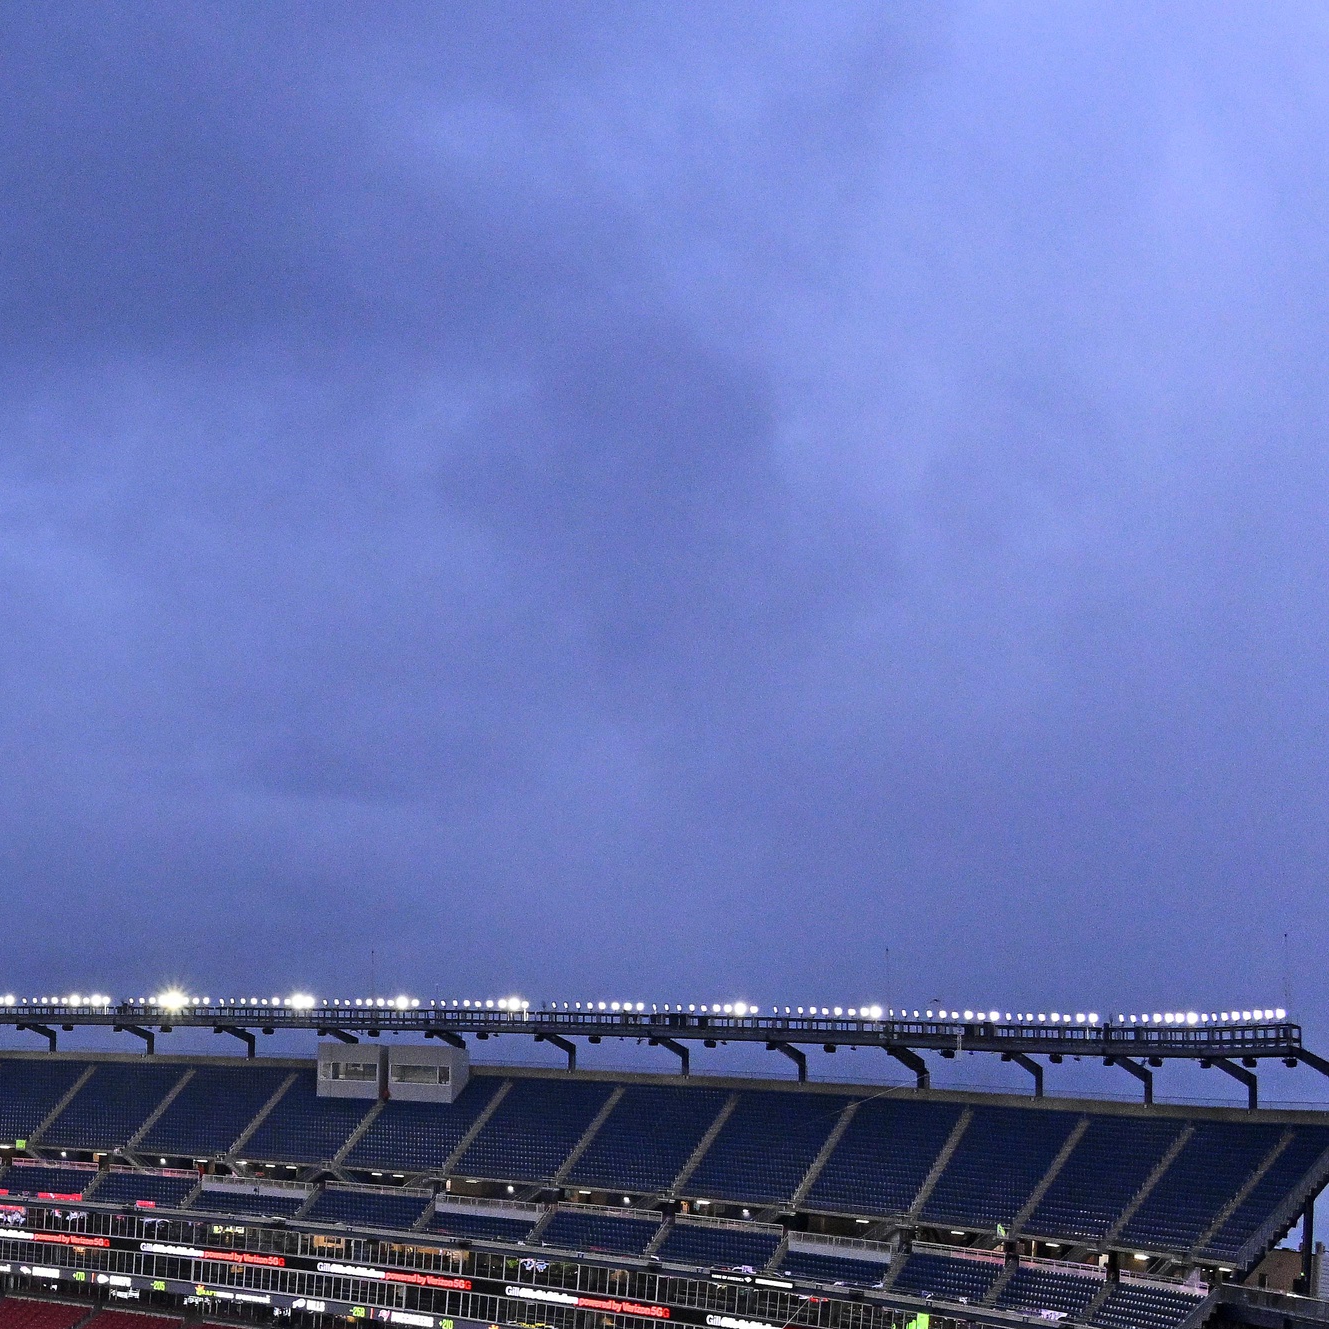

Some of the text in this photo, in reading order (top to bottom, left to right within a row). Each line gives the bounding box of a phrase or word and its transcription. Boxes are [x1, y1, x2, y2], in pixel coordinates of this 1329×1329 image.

[33, 1232, 62, 1243] powered
[62, 1235, 70, 1245] by
[70, 1235, 94, 1245] Verizon
[203, 1249, 234, 1261] powered
[234, 1252, 243, 1263] by
[243, 1253, 268, 1266] Verizon
[385, 1271, 453, 1288] powered by Verizon
[578, 1297, 651, 1315] powered by Verizon
